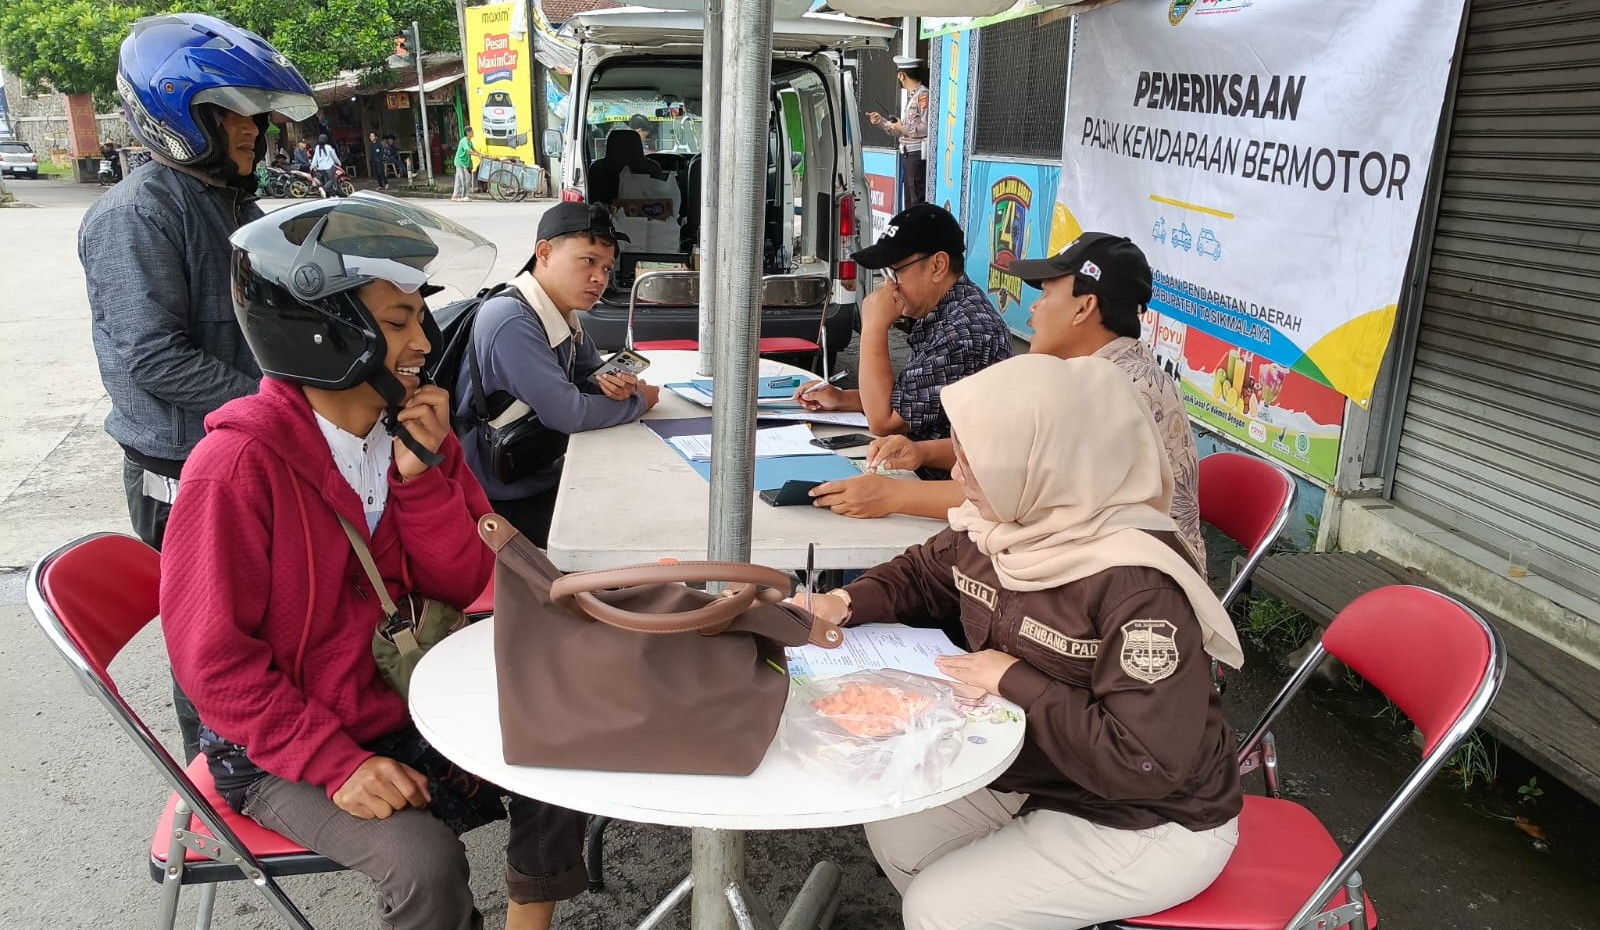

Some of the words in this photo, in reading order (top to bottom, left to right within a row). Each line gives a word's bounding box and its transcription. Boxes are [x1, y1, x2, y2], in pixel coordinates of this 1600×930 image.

[482, 9, 508, 23] maxim
[485, 37, 508, 51] Pesan
[478, 52, 516, 70] MaximCar
[1133, 71, 1306, 121] PEMERIKSAAN
[1081, 116, 1120, 155] PAJAK
[1122, 123, 1241, 176] KENDARAAN
[1242, 139, 1410, 201] BERMOTOR
[1152, 286, 1197, 316] KABUPATEN
[1200, 305, 1270, 344] TASIKMALAYA
[1182, 279, 1247, 316] PENDAPATAN
[1251, 302, 1302, 333] DAERAH
[1159, 326, 1182, 345] FOYU
[1227, 412, 1245, 429] Dengan
[1023, 621, 1067, 651] RENBANG
[1071, 642, 1098, 656] PAD
